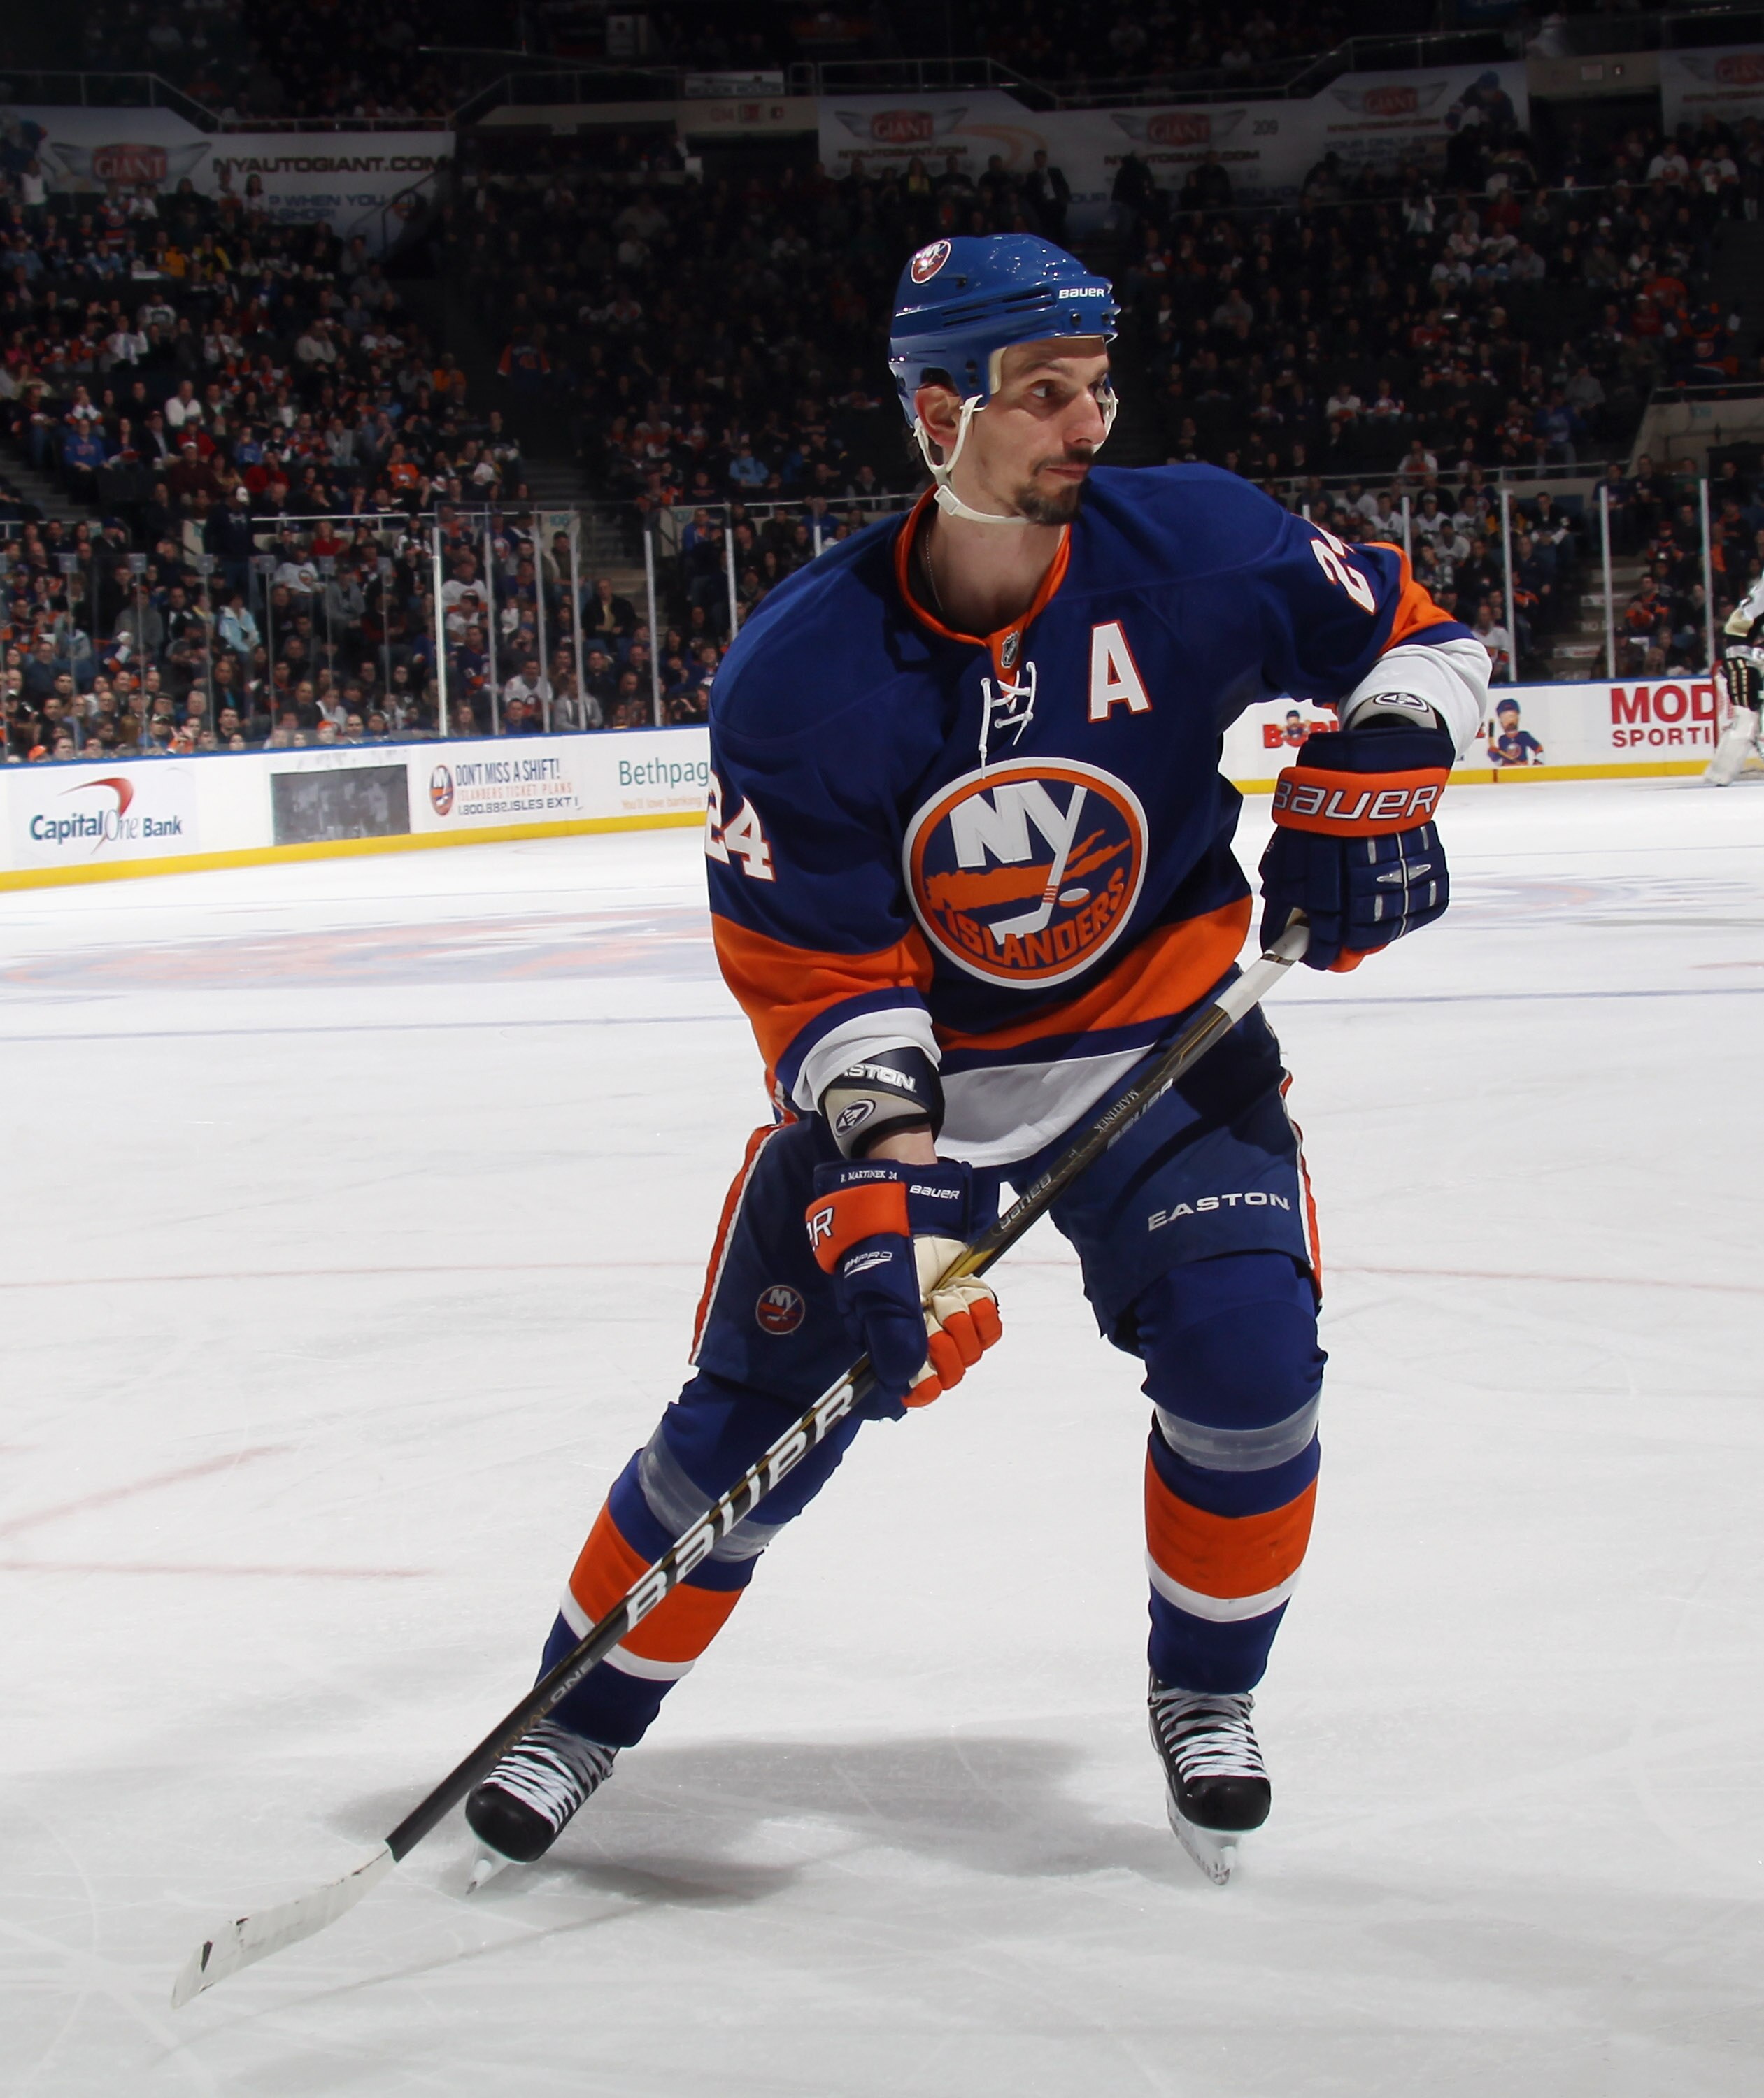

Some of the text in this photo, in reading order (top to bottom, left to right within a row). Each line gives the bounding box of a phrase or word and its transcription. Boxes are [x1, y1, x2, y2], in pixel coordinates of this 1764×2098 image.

[94, 154, 166, 180] GIANT
[212, 155, 448, 173] NYAUTOGIANT.COM
[1310, 526, 1378, 615] 2
[1088, 618, 1153, 724] A
[1611, 684, 1714, 725] MOD
[1612, 727, 1710, 748] SPORTI
[455, 758, 560, 787] DON'T MISS A SHIFT!
[542, 782, 573, 796] PLANS
[547, 797, 571, 809] EXT
[143, 814, 183, 838] Bank
[943, 867, 1125, 969] ISLANDERS
[844, 1062, 917, 1092] STON
[1093, 1088, 1139, 1133] MARTINEK
[848, 1170, 886, 1180] MARTINEK
[888, 1171, 897, 1180] 24
[1148, 1192, 1290, 1232] EASTON
[806, 1207, 834, 1252] R
